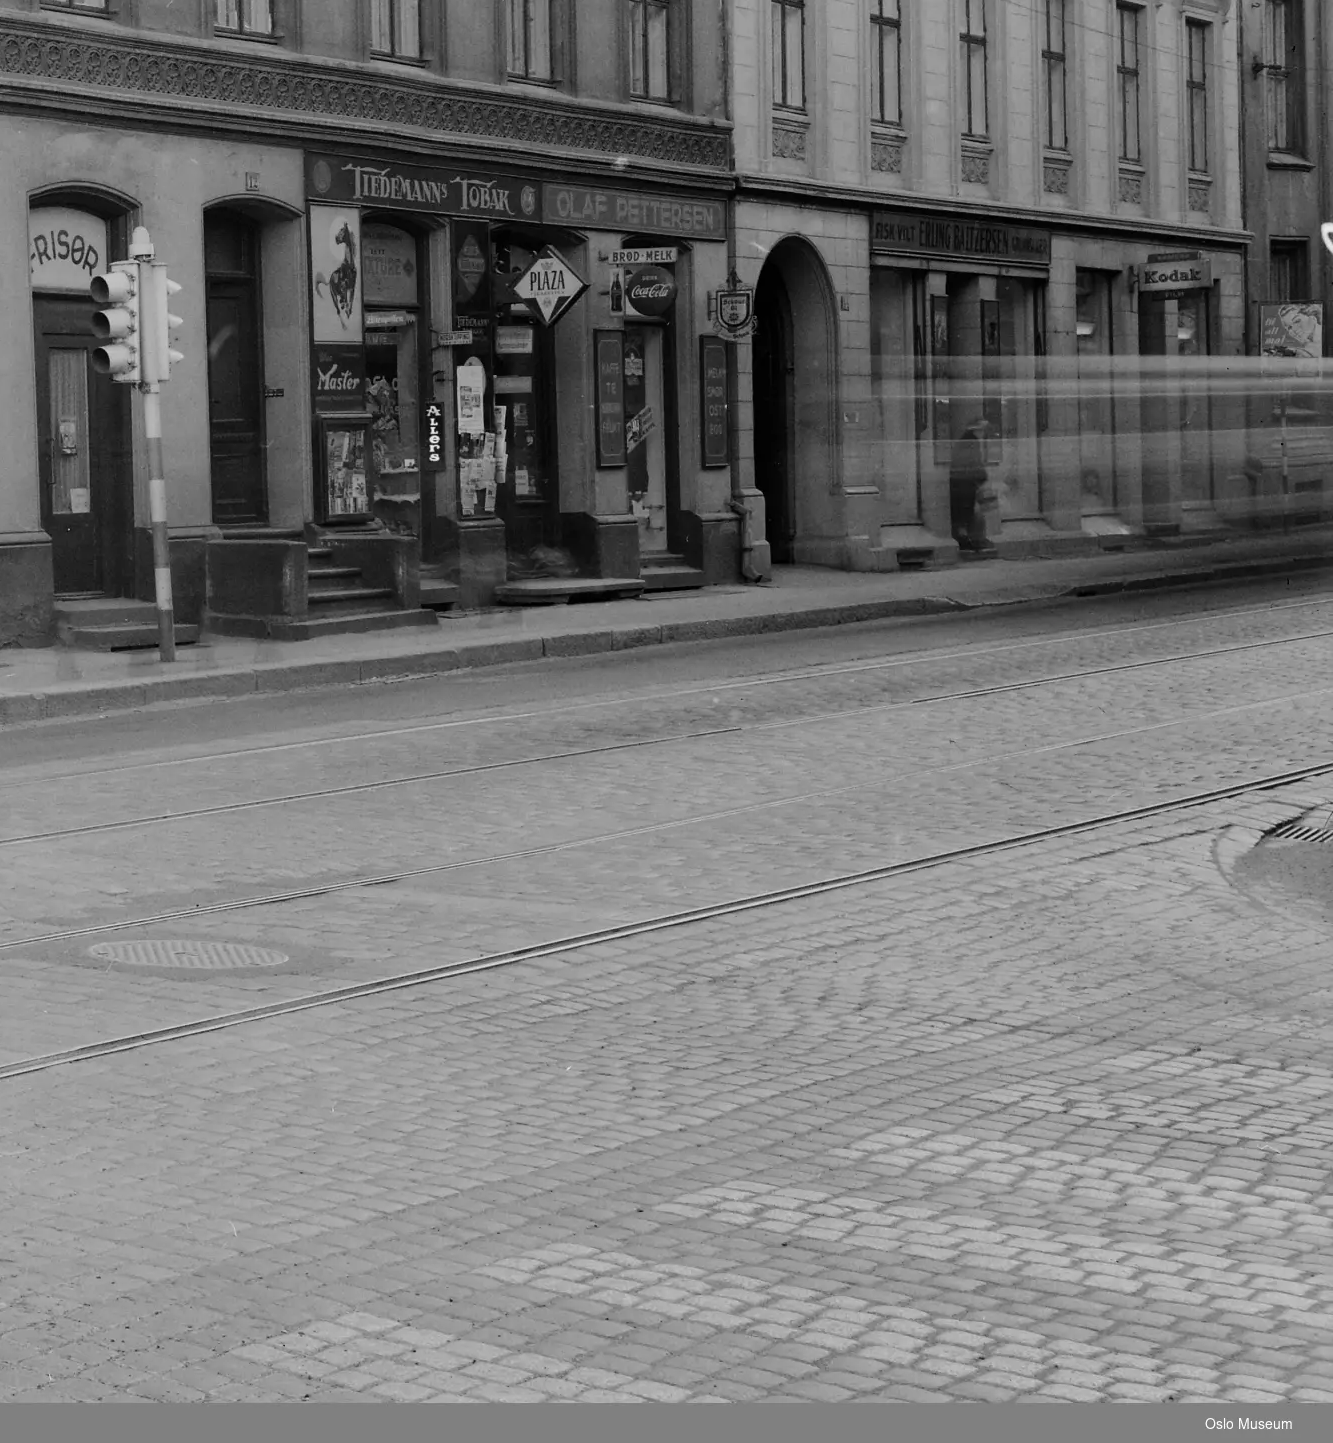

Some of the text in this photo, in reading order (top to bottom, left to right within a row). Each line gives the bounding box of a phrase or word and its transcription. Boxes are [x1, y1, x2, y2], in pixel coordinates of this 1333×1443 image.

[341, 163, 516, 216] TIEDEMANNS TOBAK
[556, 191, 714, 231] OLAF PETTERSEN
[31, 229, 99, 277] RISØR
[529, 269, 566, 291] PLAZA
[1144, 267, 1202, 285] Kodak
[317, 363, 361, 390] Master
